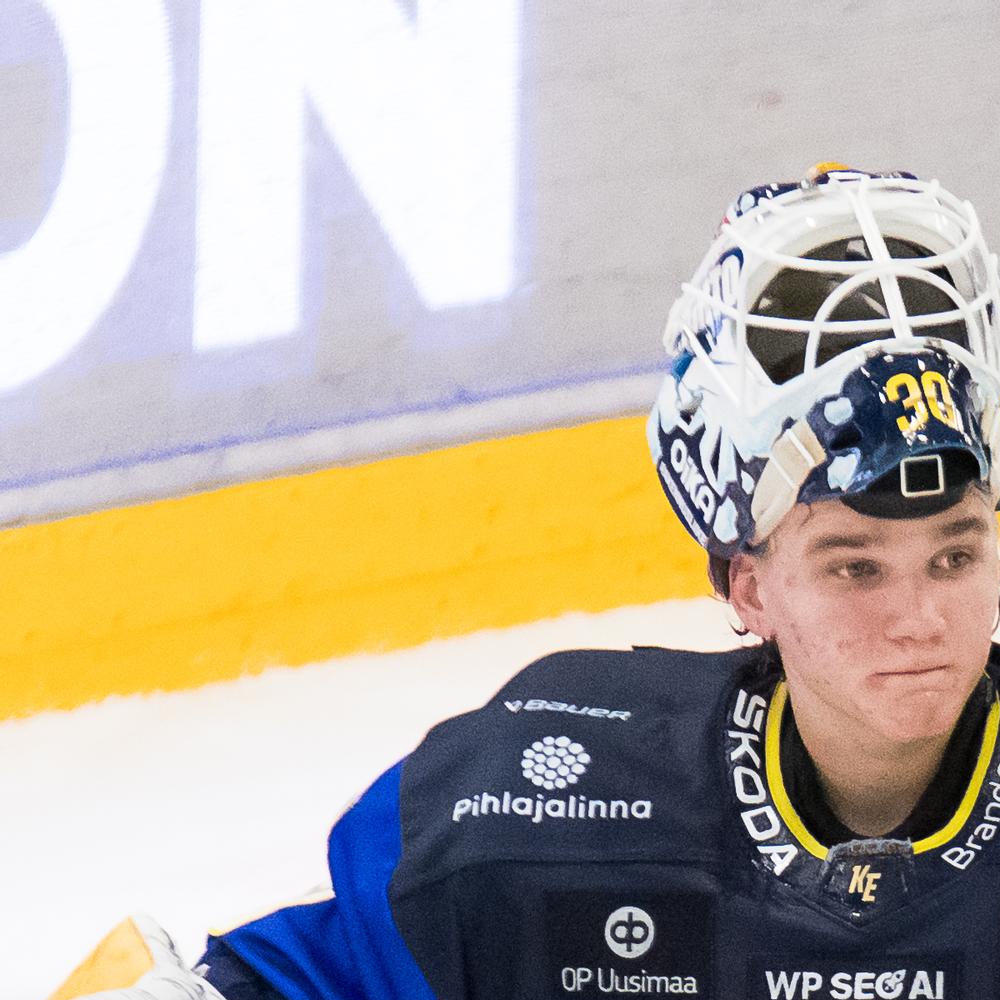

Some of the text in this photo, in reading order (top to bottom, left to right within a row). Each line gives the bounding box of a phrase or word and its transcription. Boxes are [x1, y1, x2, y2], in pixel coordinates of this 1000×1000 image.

[886, 371, 960, 433] 30
[848, 865, 882, 902] KE
[561, 967, 698, 994] OP Uusimaa
[765, 971, 823, 1000] WP
[908, 970, 945, 1000] AI
